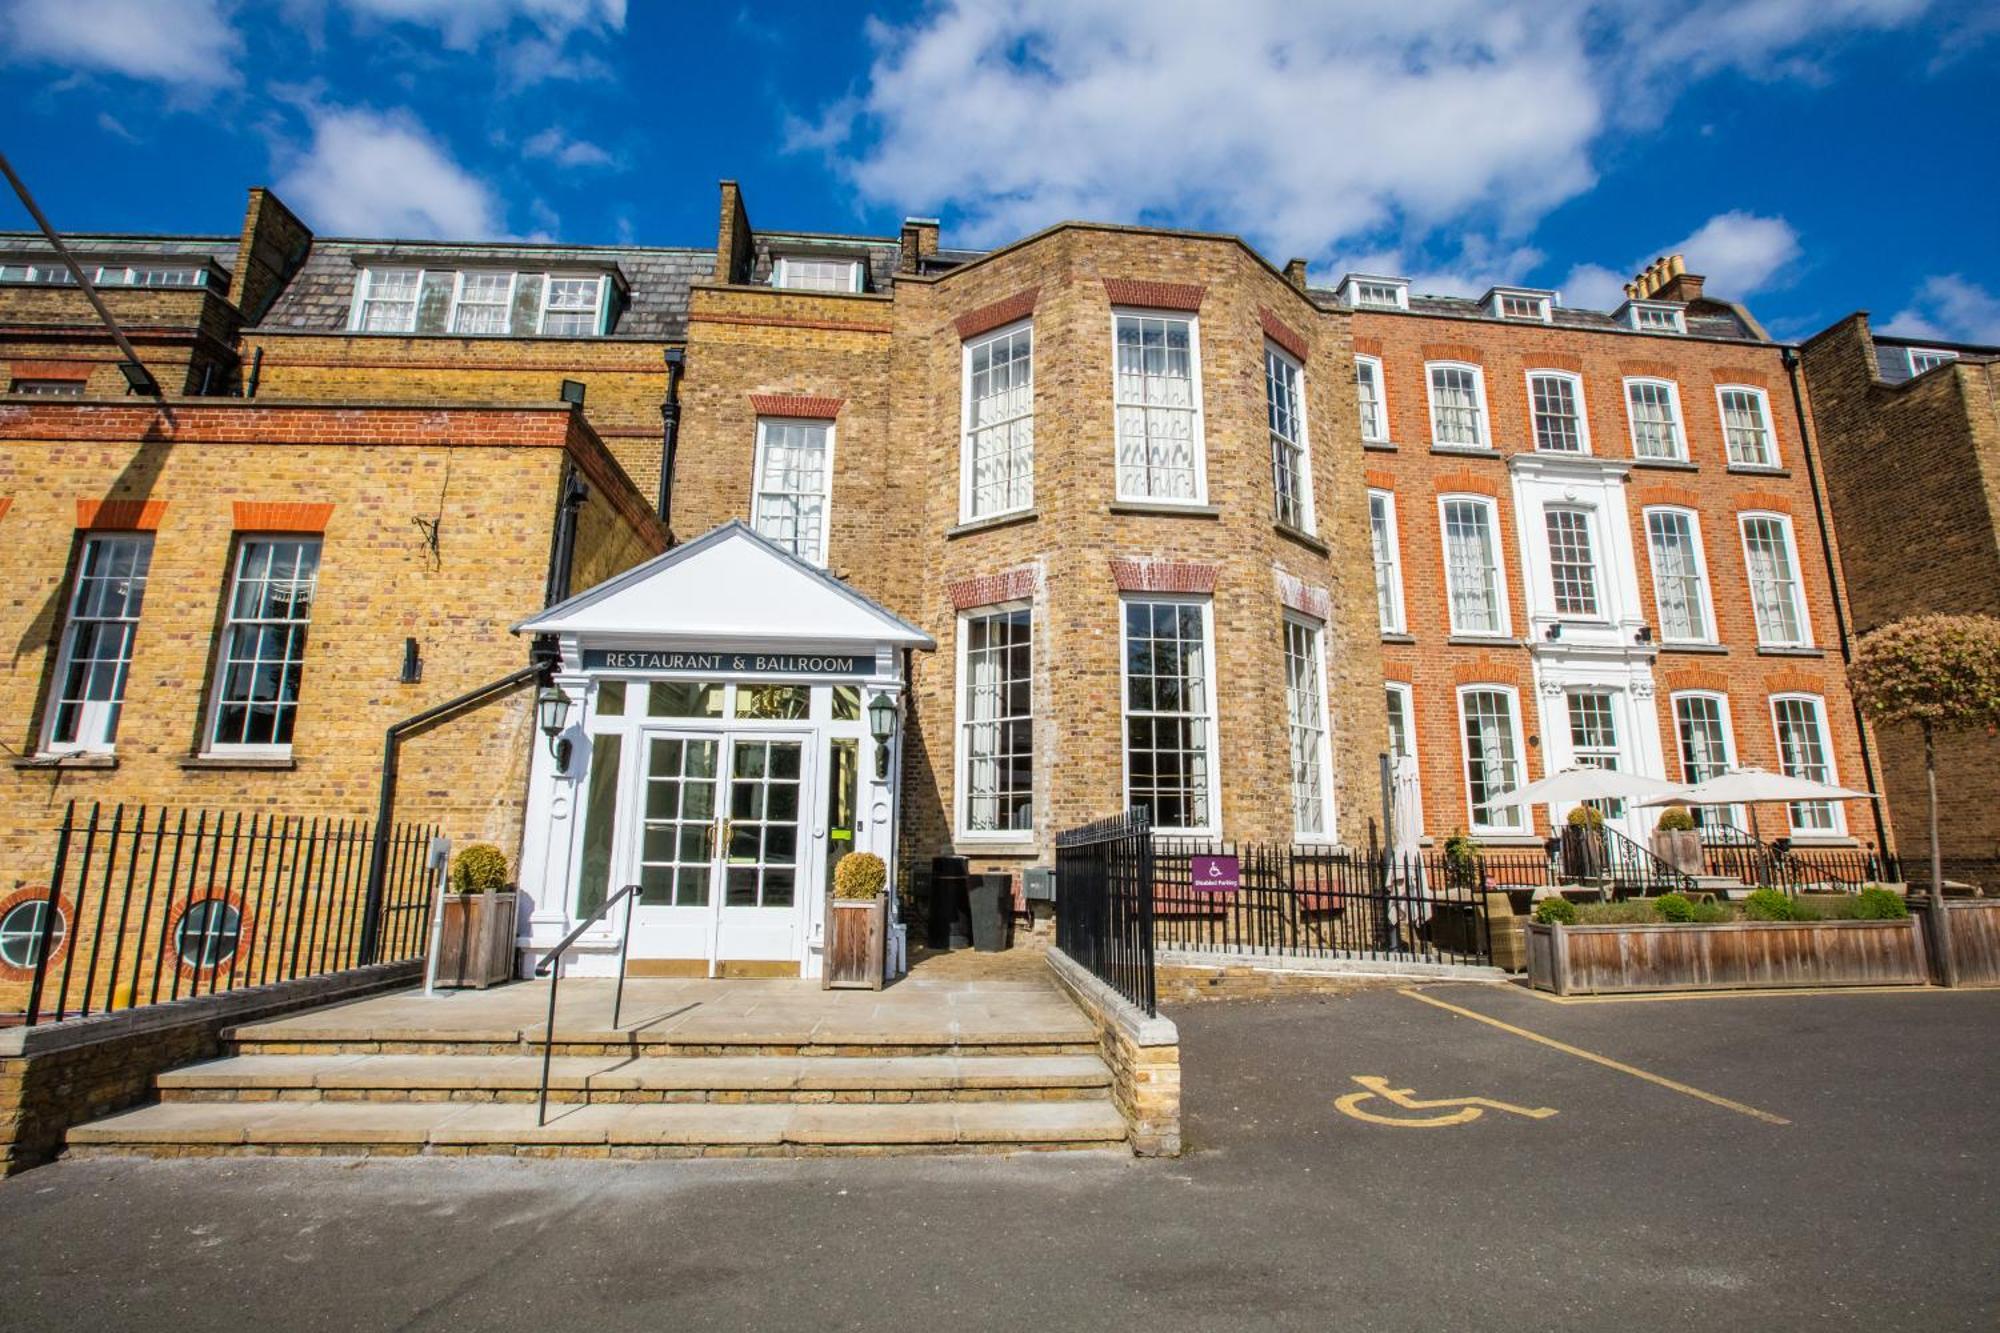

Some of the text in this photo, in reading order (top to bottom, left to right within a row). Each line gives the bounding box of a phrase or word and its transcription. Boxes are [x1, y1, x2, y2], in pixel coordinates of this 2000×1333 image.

[606, 653, 854, 672] RESTAURANT & BALLROOM
